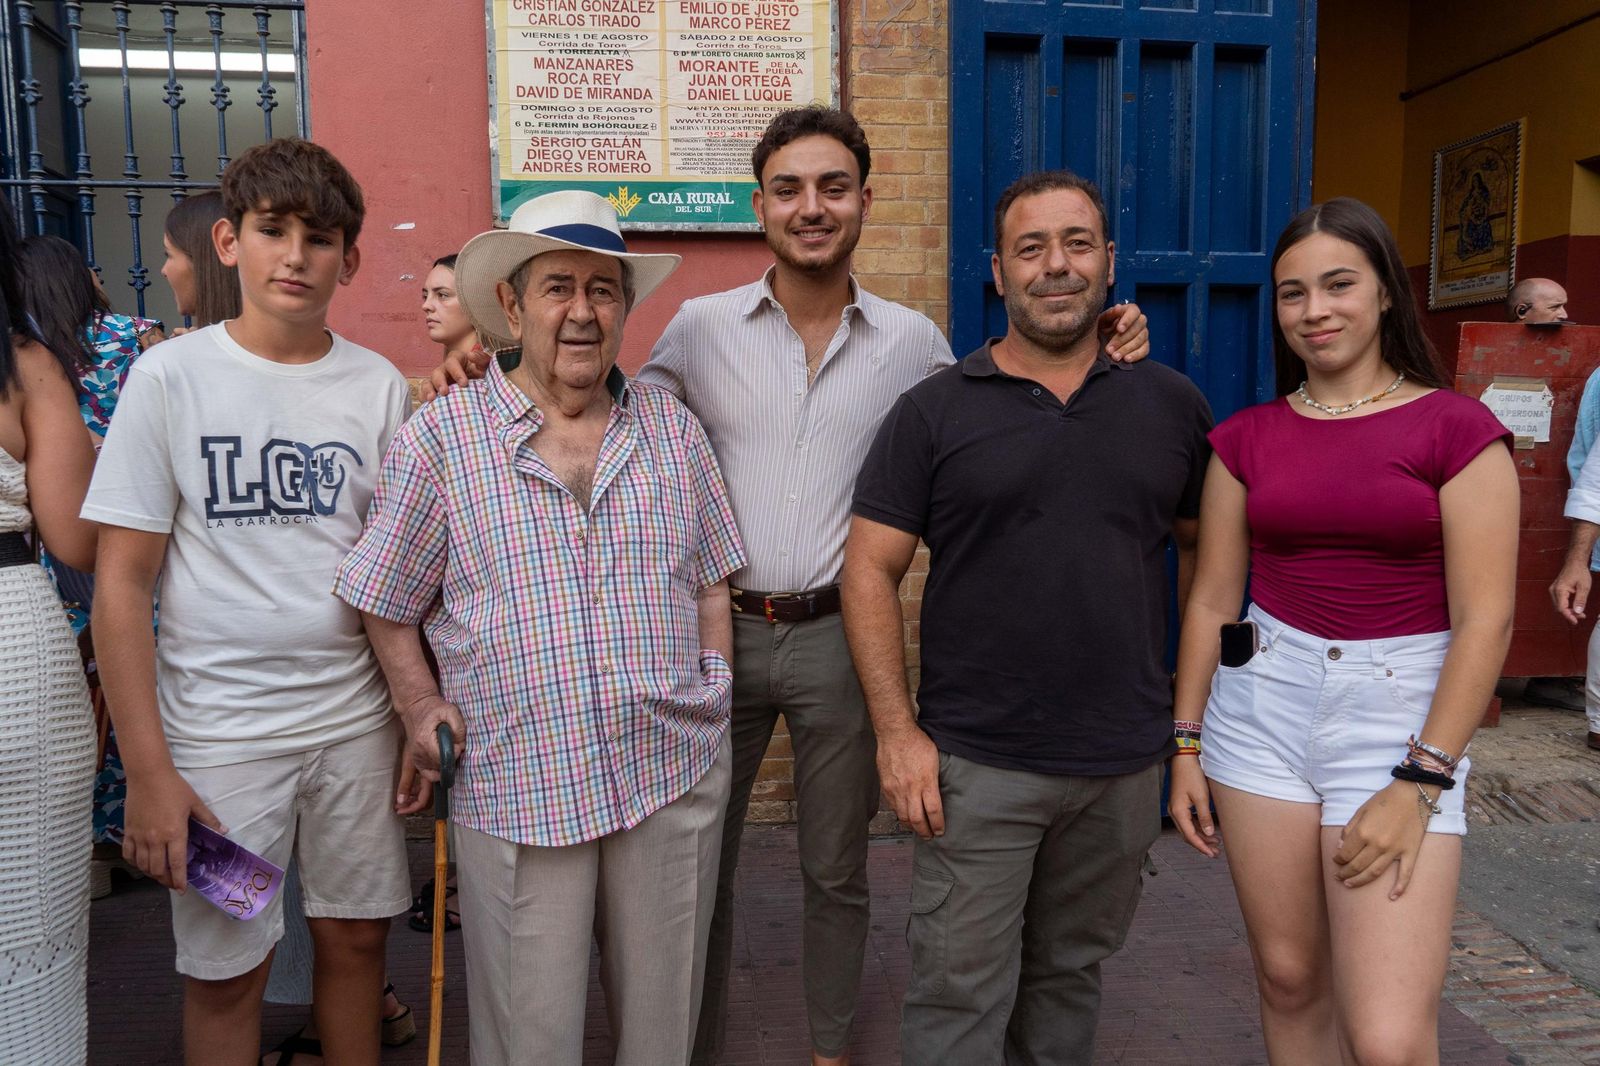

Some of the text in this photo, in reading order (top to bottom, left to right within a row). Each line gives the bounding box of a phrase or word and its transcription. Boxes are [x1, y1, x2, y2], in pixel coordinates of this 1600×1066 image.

[513, 0, 577, 12] CRISTIAN
[680, 2, 799, 17] EMILIO DE JUSTO
[528, 13, 641, 28] CARLOS TIRADO
[689, 15, 791, 31] MARCO PÉREZ
[521, 32, 571, 40] VIERNES
[680, 33, 727, 41] SÁBADO
[538, 40, 579, 48] Corrida
[581, 40, 594, 48] de
[534, 57, 634, 71] MANZANARES
[679, 60, 759, 73] MORANTE
[548, 72, 622, 86] ROCA REY
[688, 74, 792, 88] JUAN ORTEGA
[516, 86, 653, 100] DAVID DE MIRANDA
[688, 89, 793, 102] DANIEL LUQUE
[520, 104, 576, 113] DOMINGO
[605, 106, 653, 114] AGOSTO
[593, 114, 636, 122] Rejones
[538, 121, 579, 129] FERMÍN
[582, 122, 649, 130] BOHÓRQUEZ
[530, 136, 642, 149] SERGIO GALÁN
[527, 150, 647, 161] DIEGO VENTURA
[522, 160, 651, 174] ANDRÉS ROMERO
[648, 193, 735, 204] CAJA RURAL
[1499, 394, 1533, 403] GRUPOS
[1506, 409, 1545, 418] PERSONA
[206, 520, 224, 529] LA
